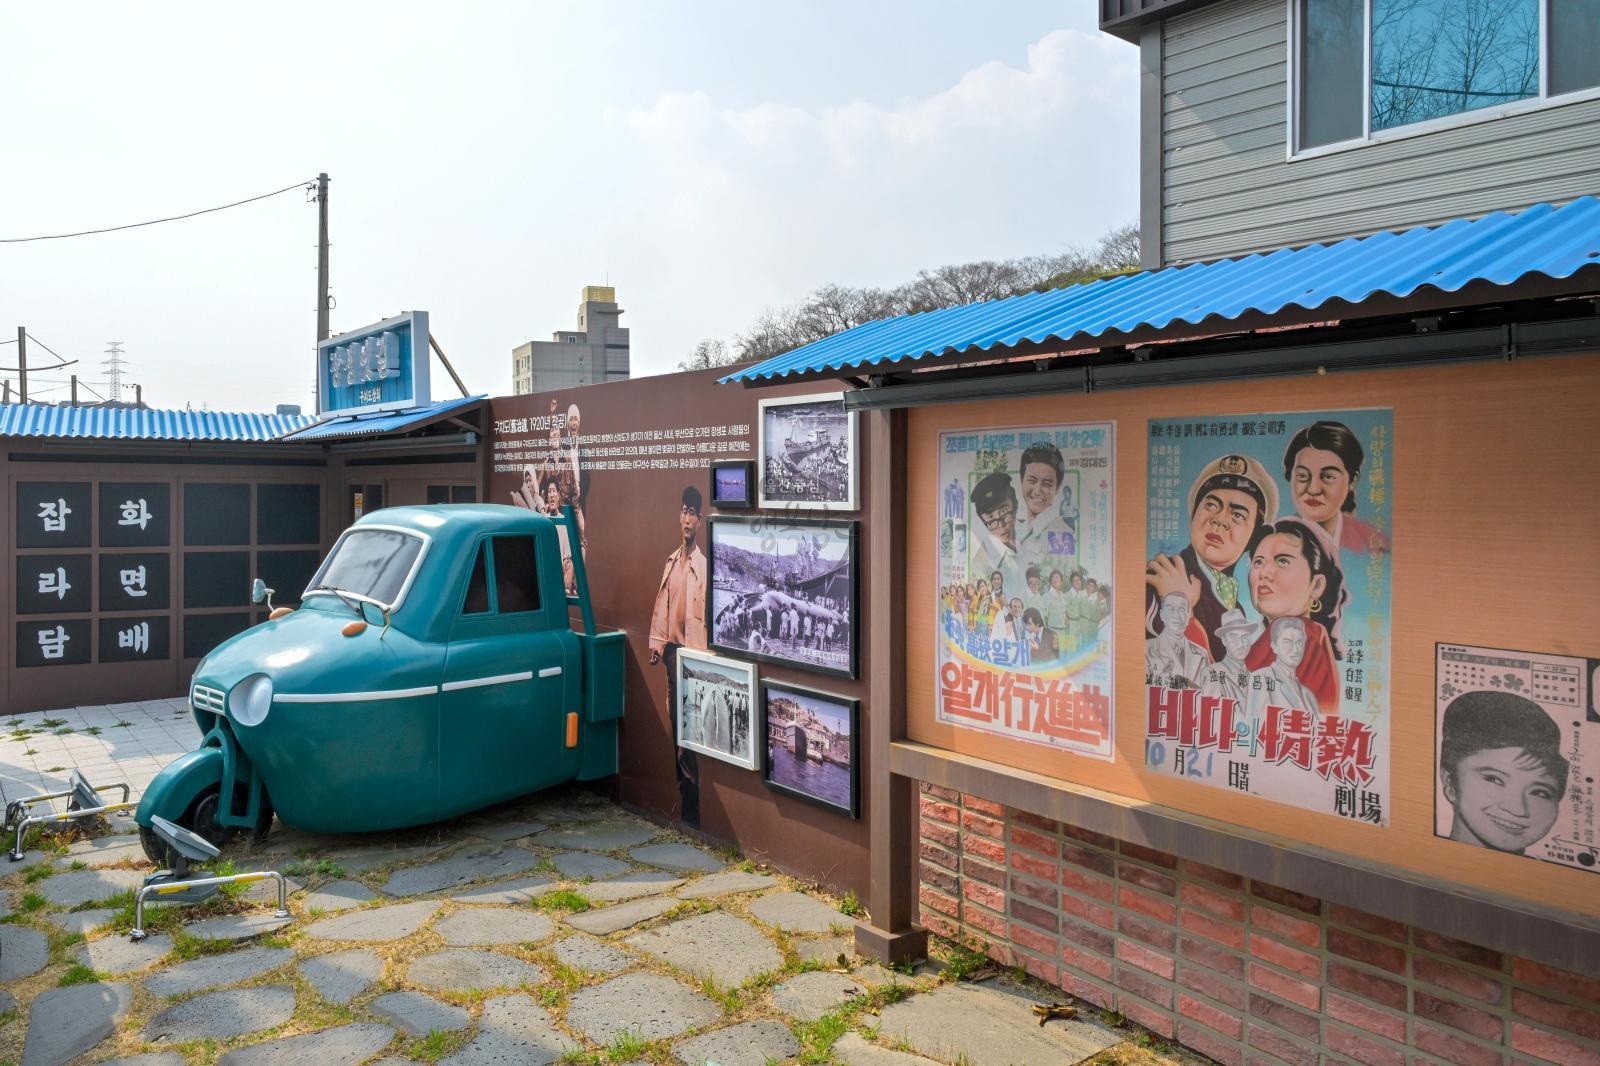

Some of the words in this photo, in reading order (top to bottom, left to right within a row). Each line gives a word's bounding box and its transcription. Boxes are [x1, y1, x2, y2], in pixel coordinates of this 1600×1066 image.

[530, 414, 551, 431] 1920년
[675, 428, 694, 438] 부산으로
[711, 426, 727, 436] 장생포
[727, 424, 750, 436] 사람들의
[670, 458, 678, 469] 가수
[37, 498, 153, 532] 잡화
[38, 564, 148, 600] 라면
[38, 621, 149, 659] 담배
[1148, 686, 1257, 757] 바다의
[1258, 705, 1377, 786] 情熱
